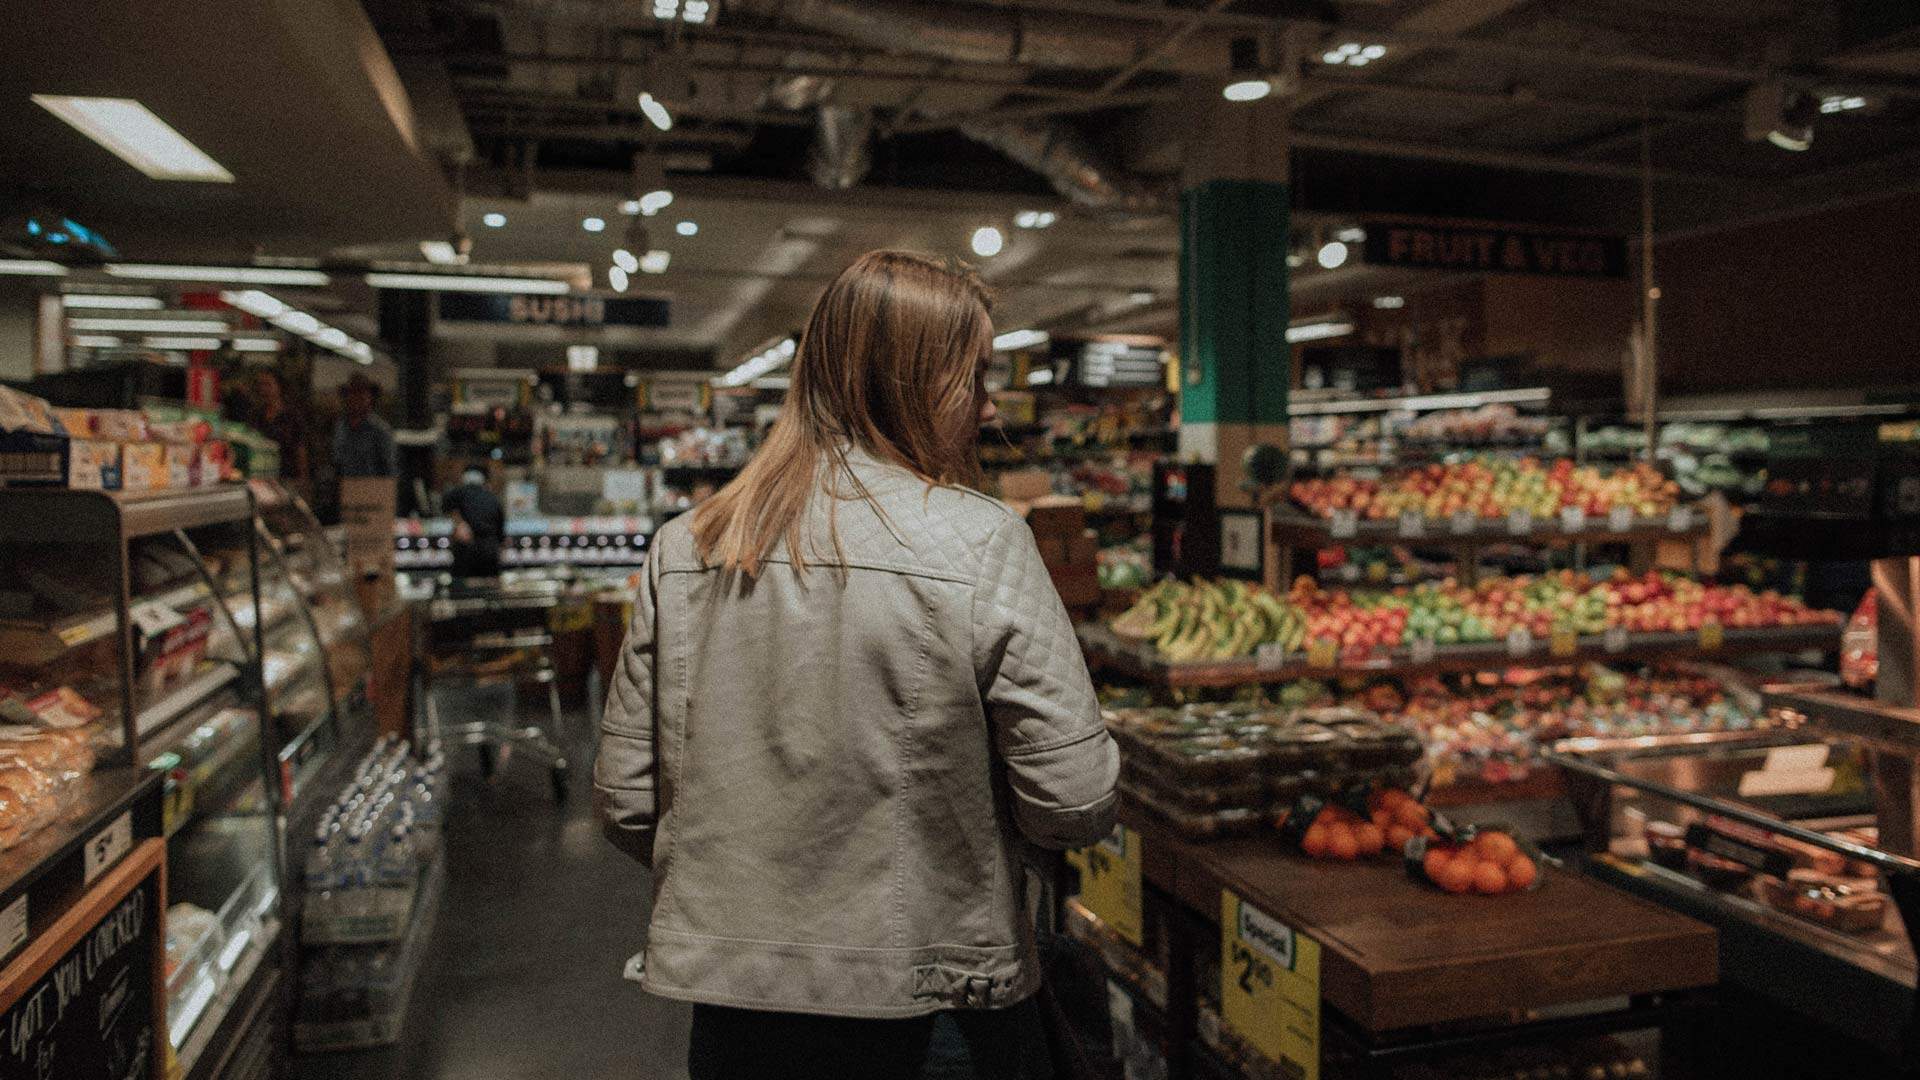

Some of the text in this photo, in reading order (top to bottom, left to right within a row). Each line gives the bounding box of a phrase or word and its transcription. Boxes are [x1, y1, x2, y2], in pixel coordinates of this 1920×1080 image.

[1388, 227, 1495, 266] FRUIT
[1502, 235, 1527, 268] &
[1244, 912, 1287, 957] Special
